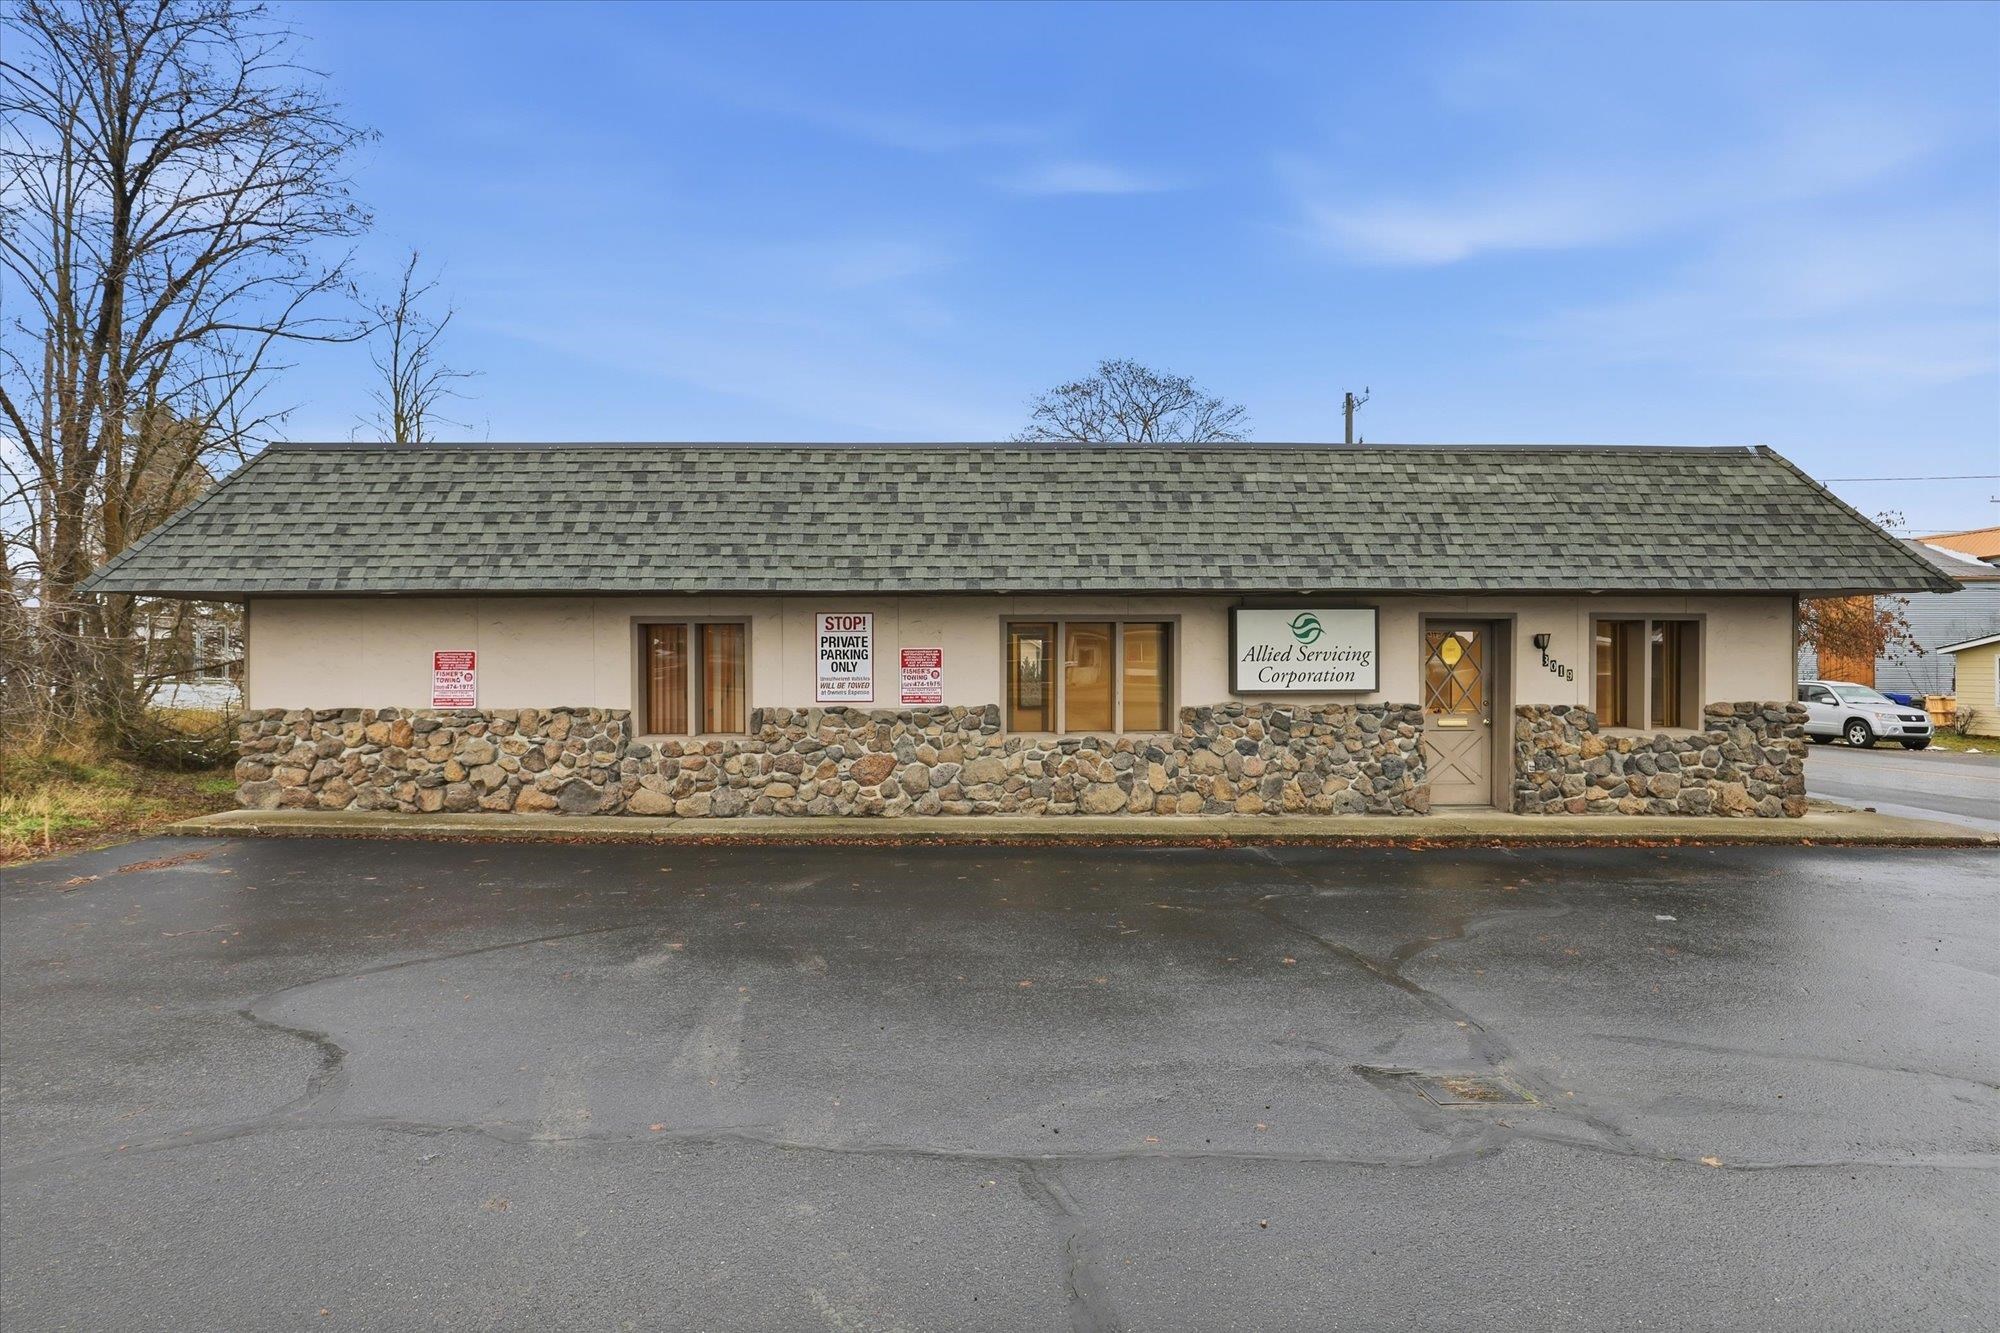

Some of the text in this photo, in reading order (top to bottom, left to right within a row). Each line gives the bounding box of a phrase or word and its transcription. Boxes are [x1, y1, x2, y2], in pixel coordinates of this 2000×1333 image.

[825, 616, 866, 631] STOP!
[821, 636, 868, 648] PRIVATE
[821, 649, 868, 660] PARKING
[1241, 644, 1372, 667] Allied Servicing
[831, 661, 857, 672] ONLY
[1543, 655, 1573, 681] 3019
[1258, 666, 1355, 688] Corporation
